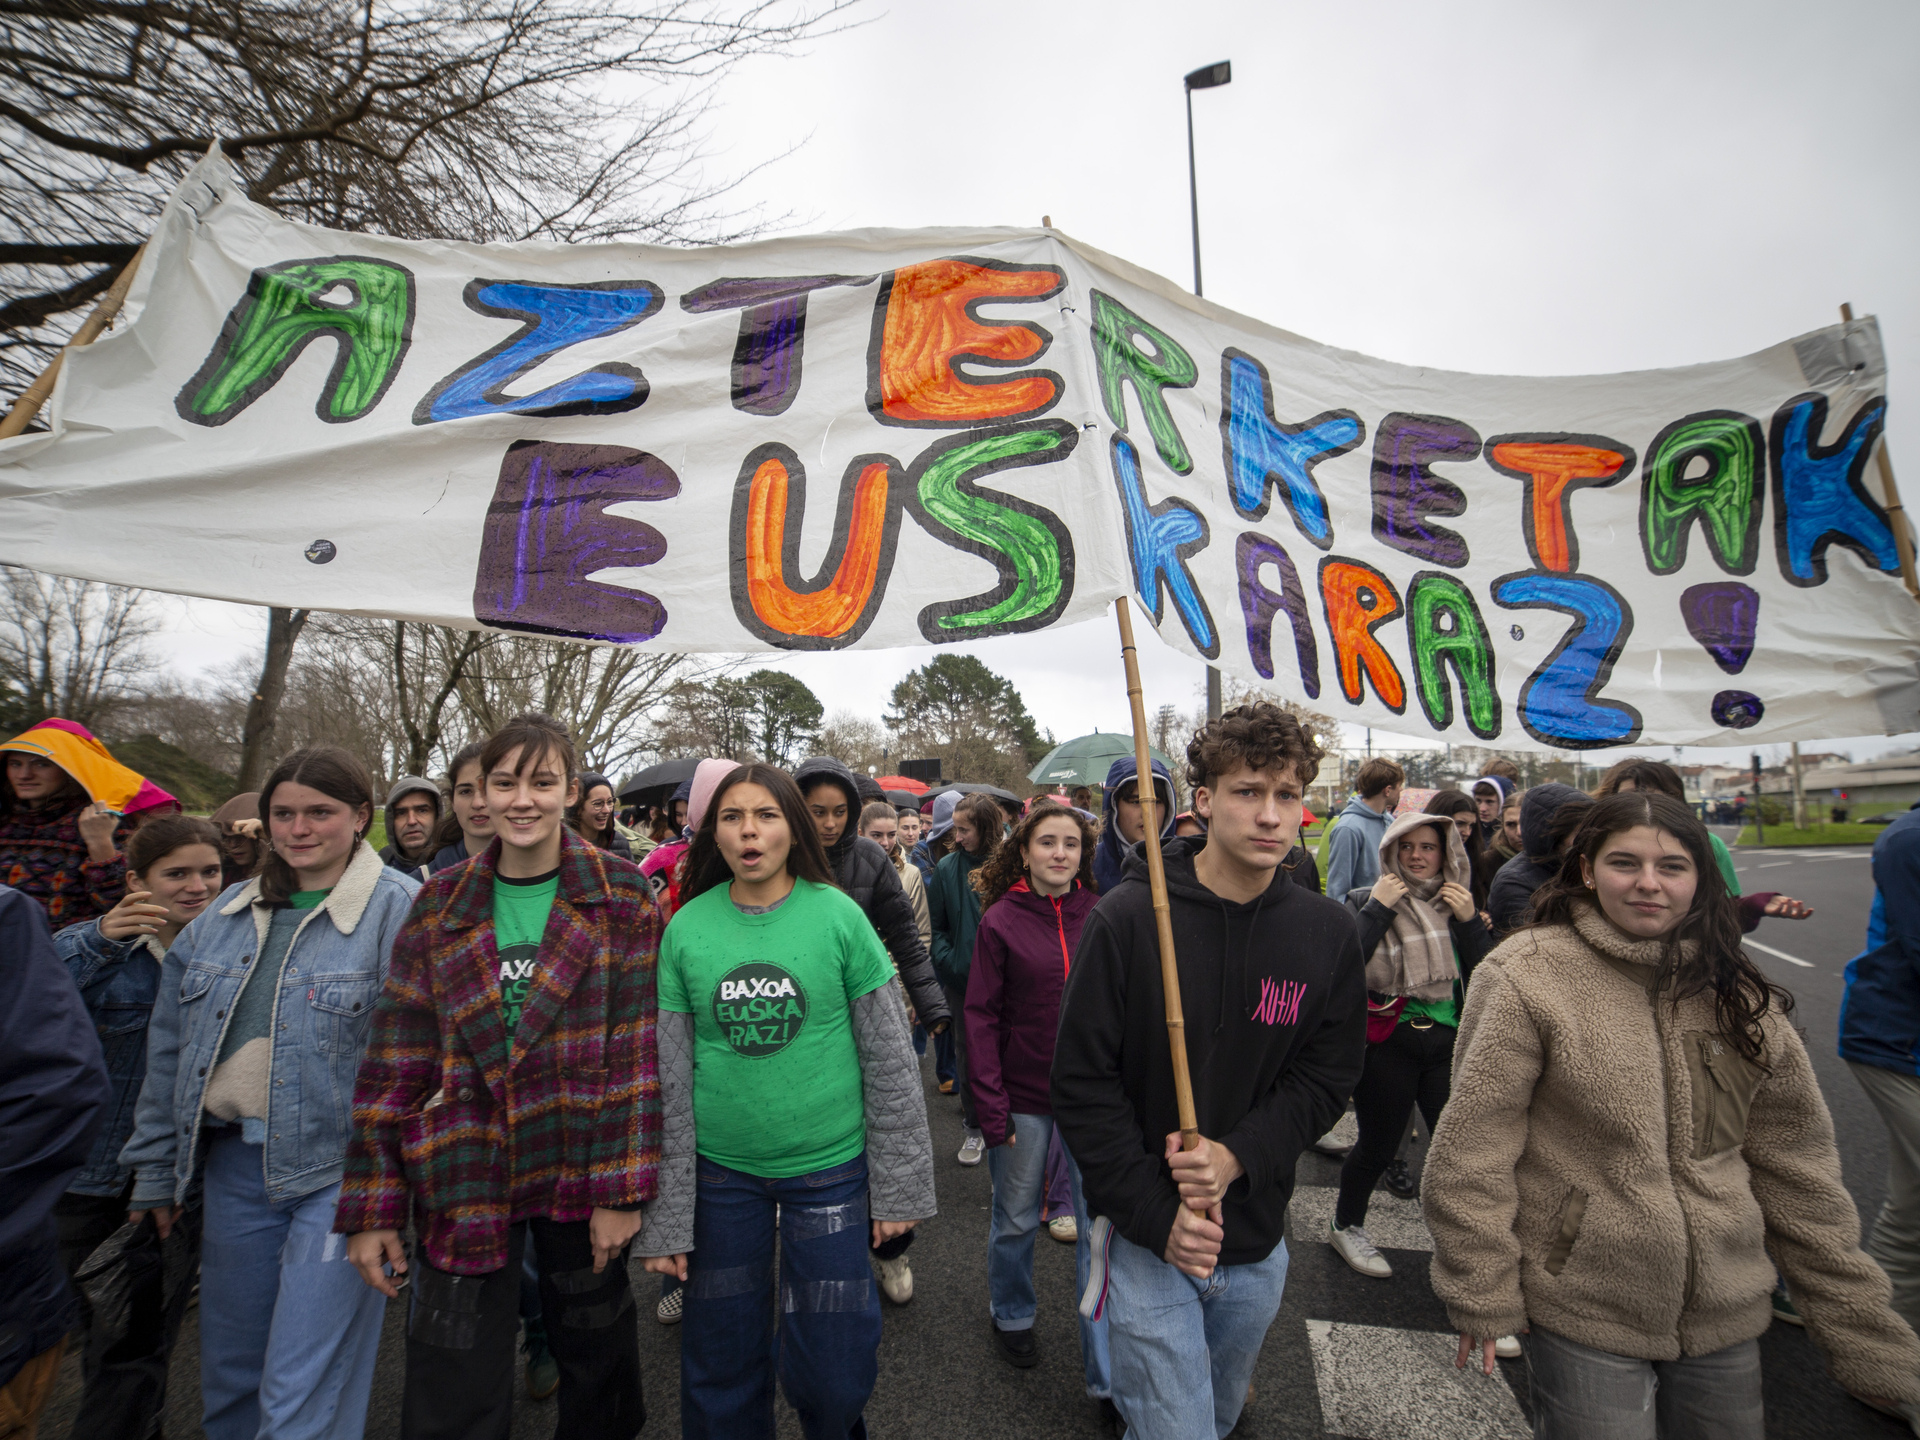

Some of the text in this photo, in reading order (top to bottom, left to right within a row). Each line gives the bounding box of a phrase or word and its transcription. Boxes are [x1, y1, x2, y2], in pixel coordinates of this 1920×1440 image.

[175, 254, 1916, 588] AZTERKETAK
[721, 977, 796, 1001] BAXOA
[729, 1022, 789, 1047] RAZ!
